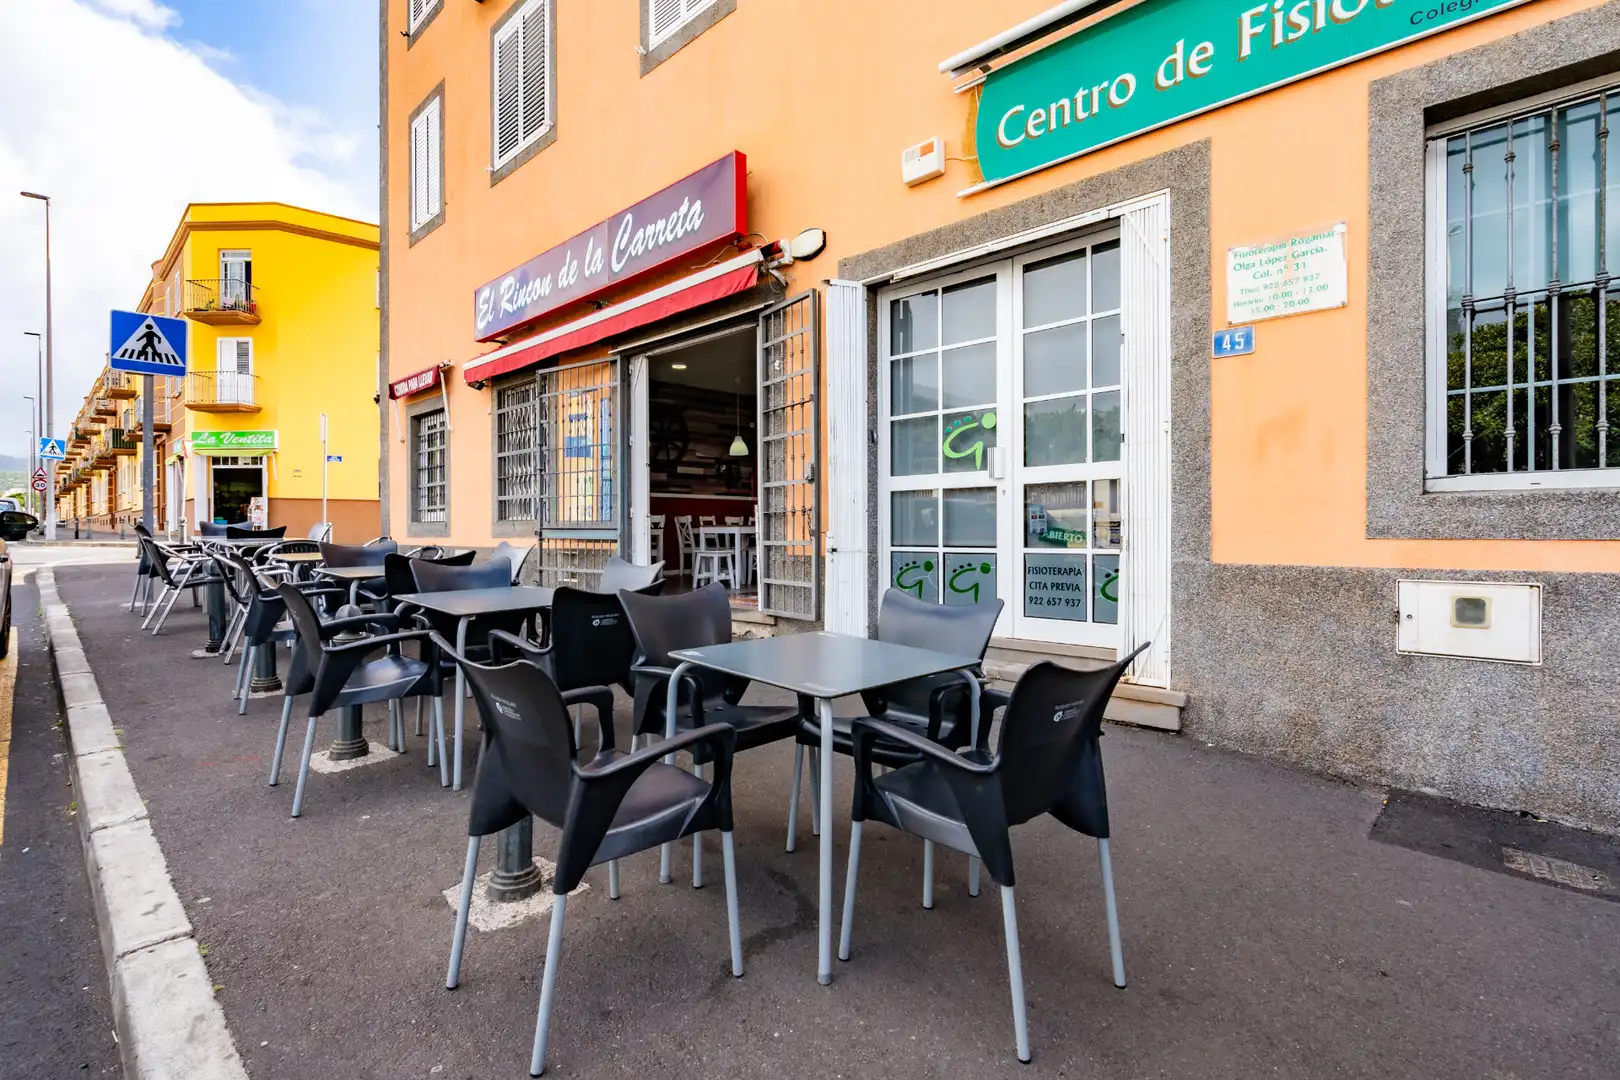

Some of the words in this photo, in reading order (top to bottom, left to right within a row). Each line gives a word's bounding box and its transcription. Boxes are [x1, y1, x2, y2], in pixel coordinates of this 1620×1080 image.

[996, 72, 1137, 149] Centro
[1154, 38, 1215, 91] de
[477, 287, 496, 331] El
[558, 249, 579, 289] de
[584, 236, 605, 278] la
[611, 196, 705, 273] Carreta
[1233, 261, 1256, 272] Olga
[1294, 261, 1306, 272] 31
[1263, 281, 1280, 291] 922
[1282, 277, 1300, 287] 657
[1303, 273, 1321, 283] 937
[1222, 332, 1245, 351] 45
[193, 431, 217, 444] La
[220, 431, 273, 444] Ventita
[1042, 530, 1083, 543] ABIERTO
[1028, 566, 1083, 577] FISIOTERAPIA
[1029, 581, 1048, 591] CITA
[1051, 582, 1081, 592] PREVIA
[1029, 596, 1044, 606] 922
[1046, 597, 1062, 606] 657
[1065, 598, 1081, 608] 937
